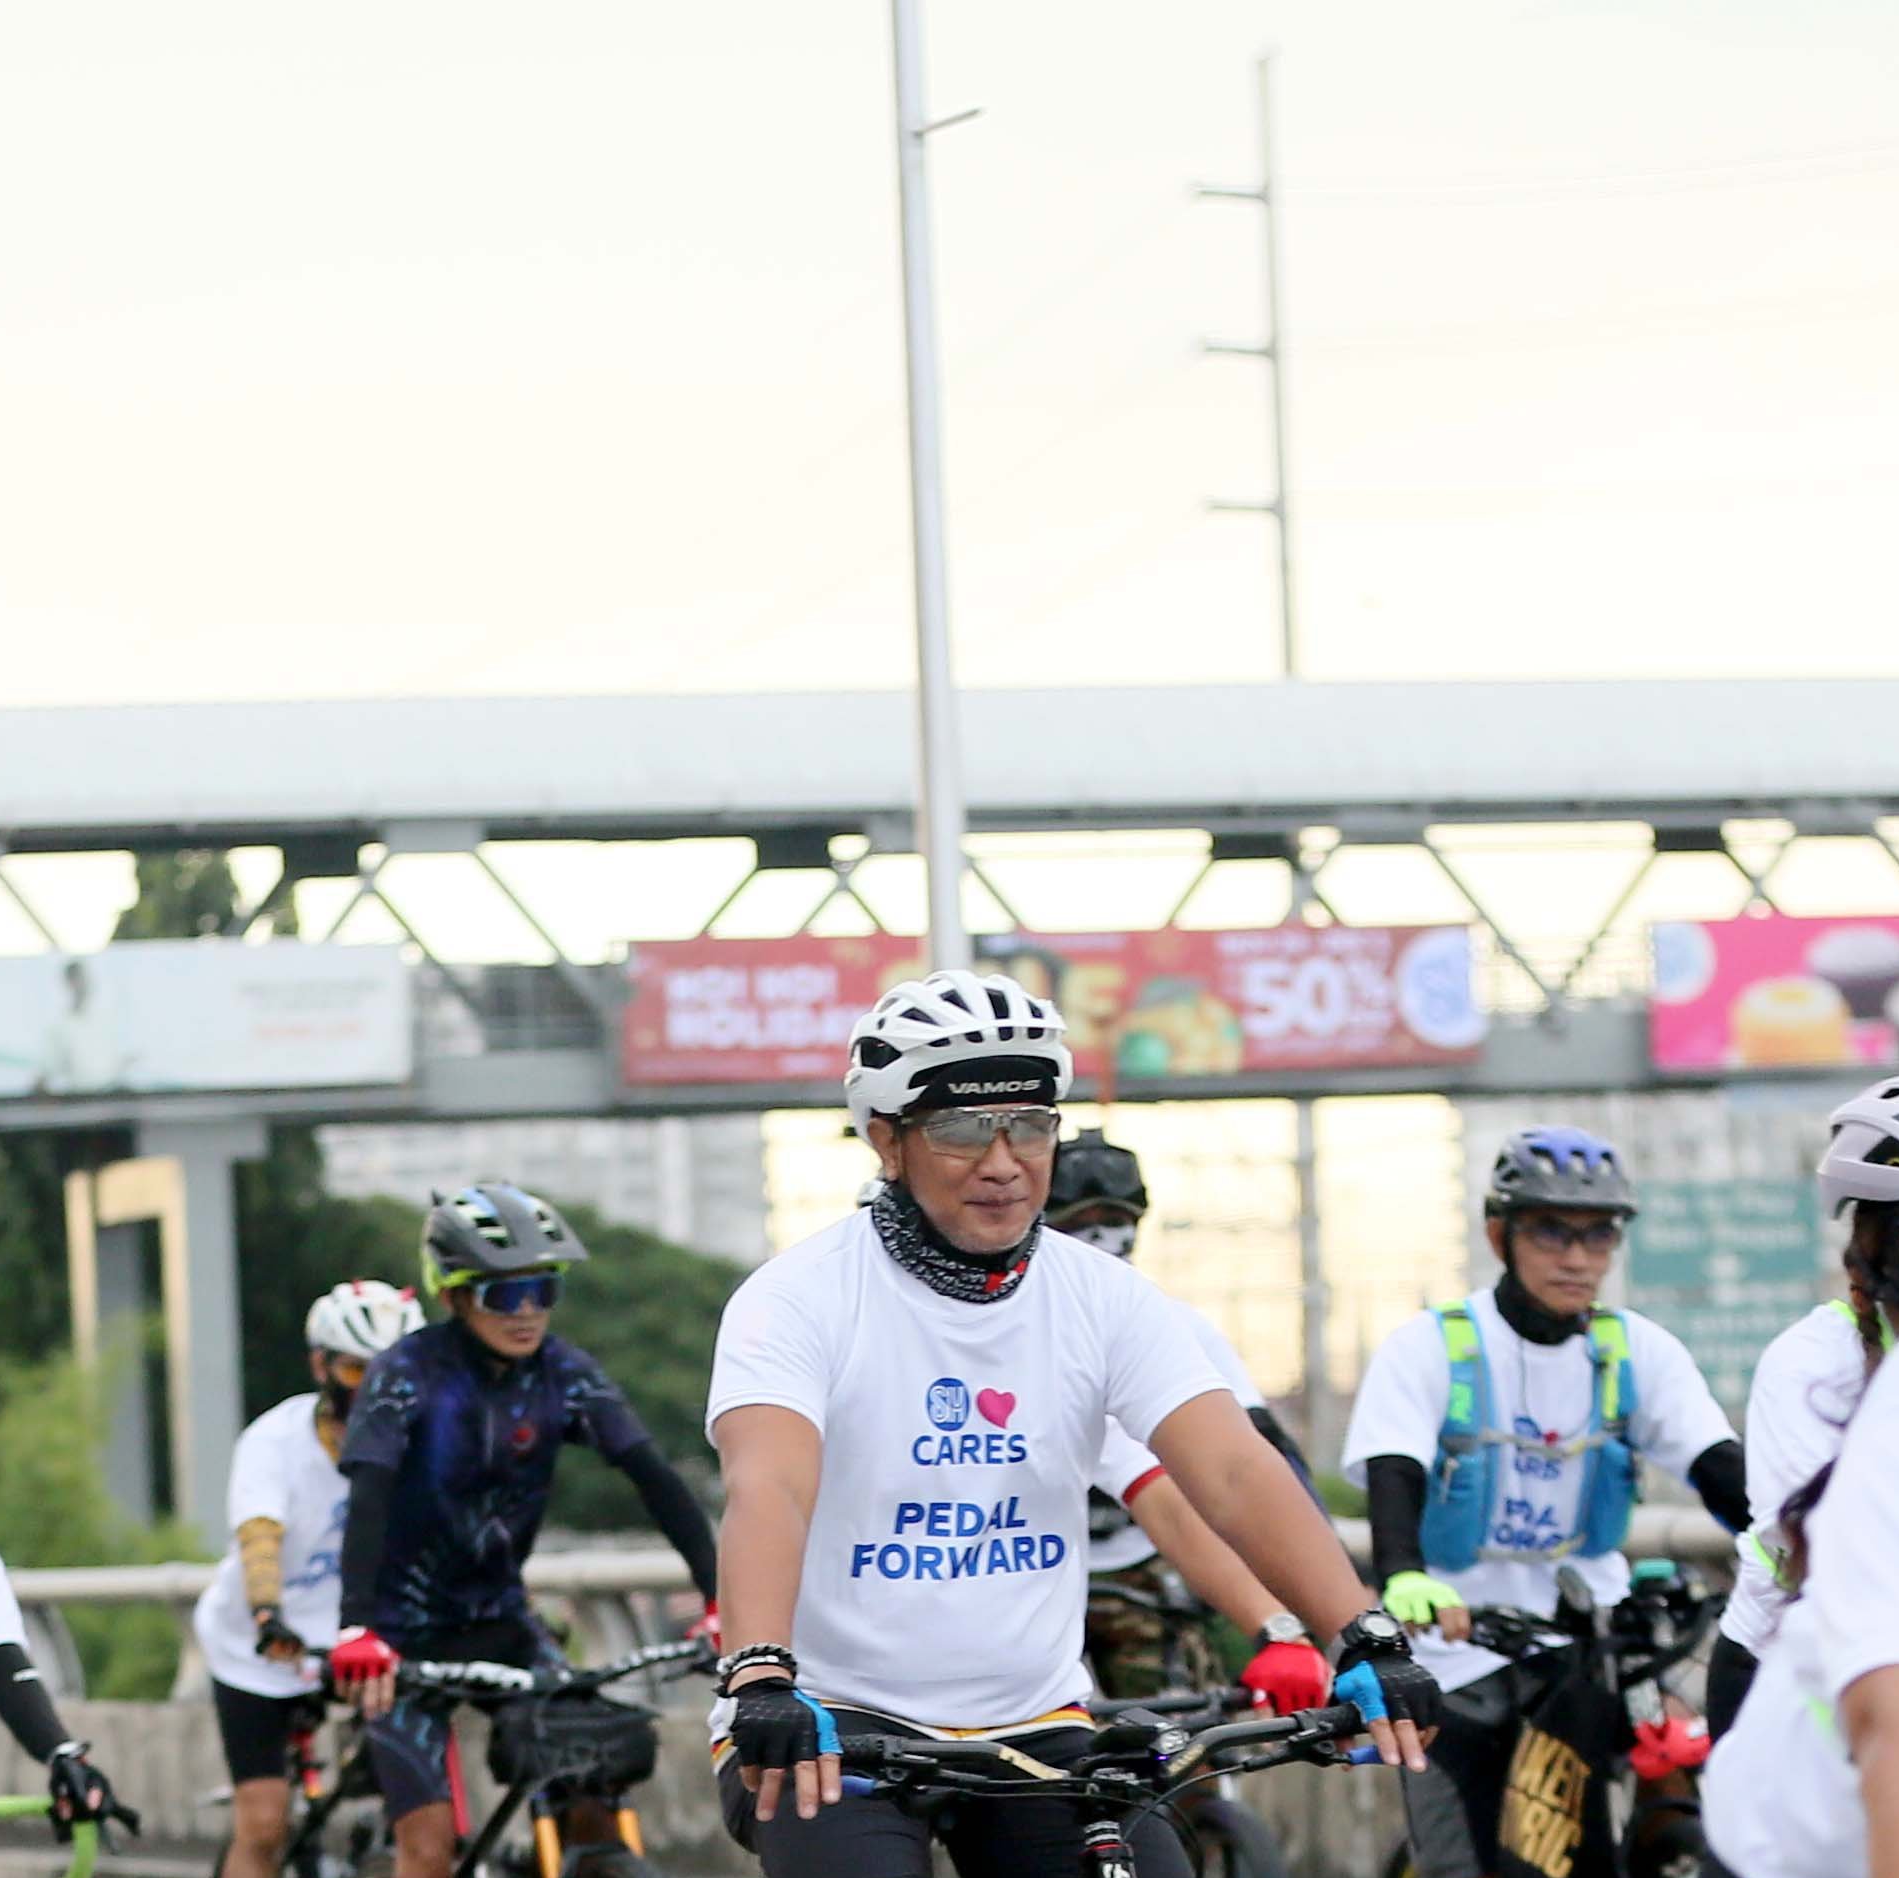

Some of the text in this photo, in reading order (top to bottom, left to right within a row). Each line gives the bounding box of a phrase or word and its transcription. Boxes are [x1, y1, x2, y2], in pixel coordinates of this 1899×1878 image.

[949, 1079, 1042, 1094] VAMOS
[912, 1433, 1028, 1466] CARES
[894, 1496, 1028, 1537] PEDAL
[850, 1534, 1066, 1580] FORWARD
